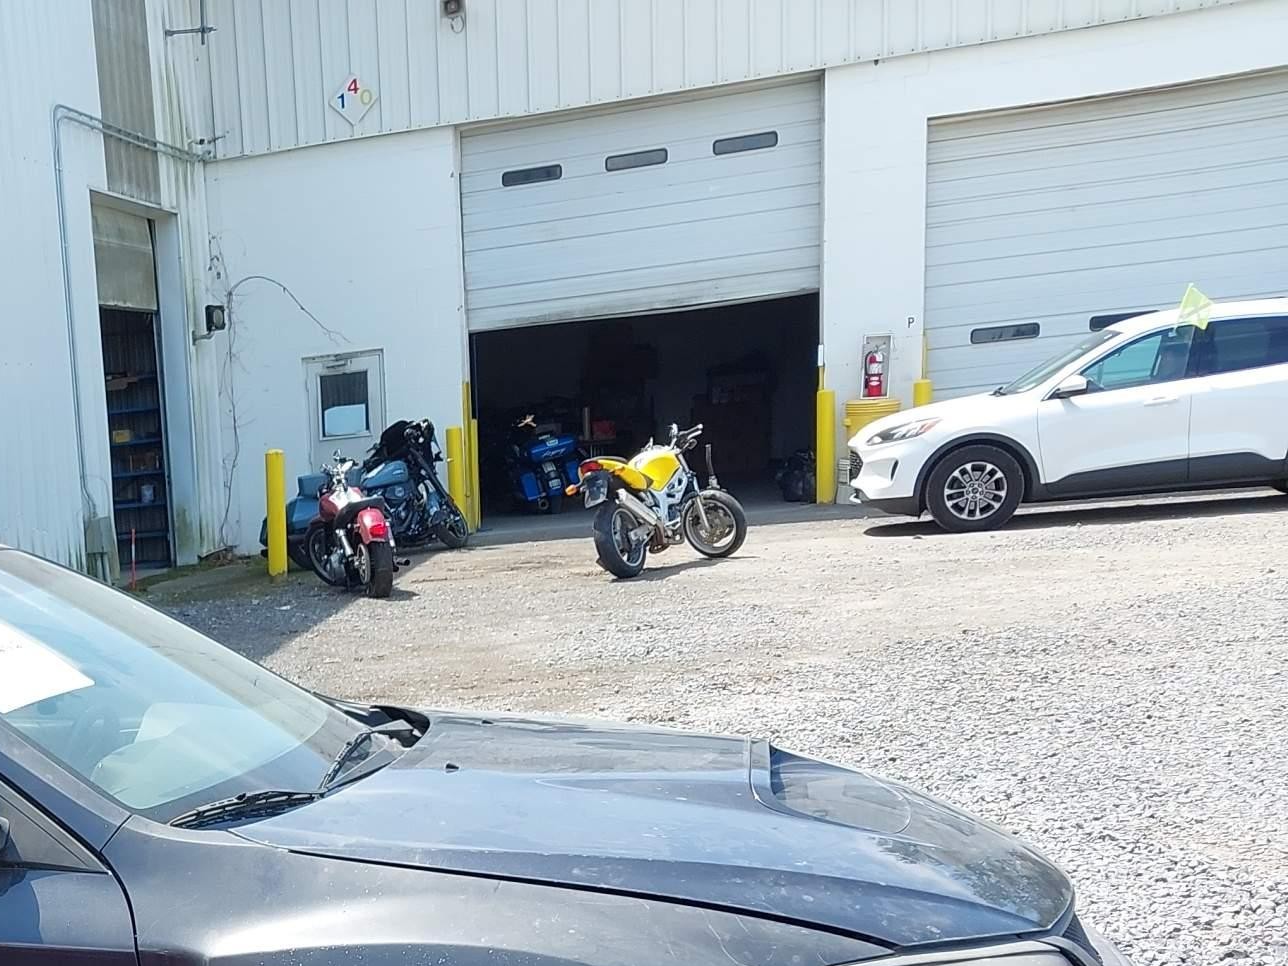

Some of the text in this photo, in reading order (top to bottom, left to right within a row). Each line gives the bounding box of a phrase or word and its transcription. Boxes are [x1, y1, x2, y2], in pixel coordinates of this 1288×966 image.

[347, 78, 360, 95] 4
[336, 92, 346, 109] 1
[359, 89, 373, 106] 0
[907, 316, 915, 329] P
